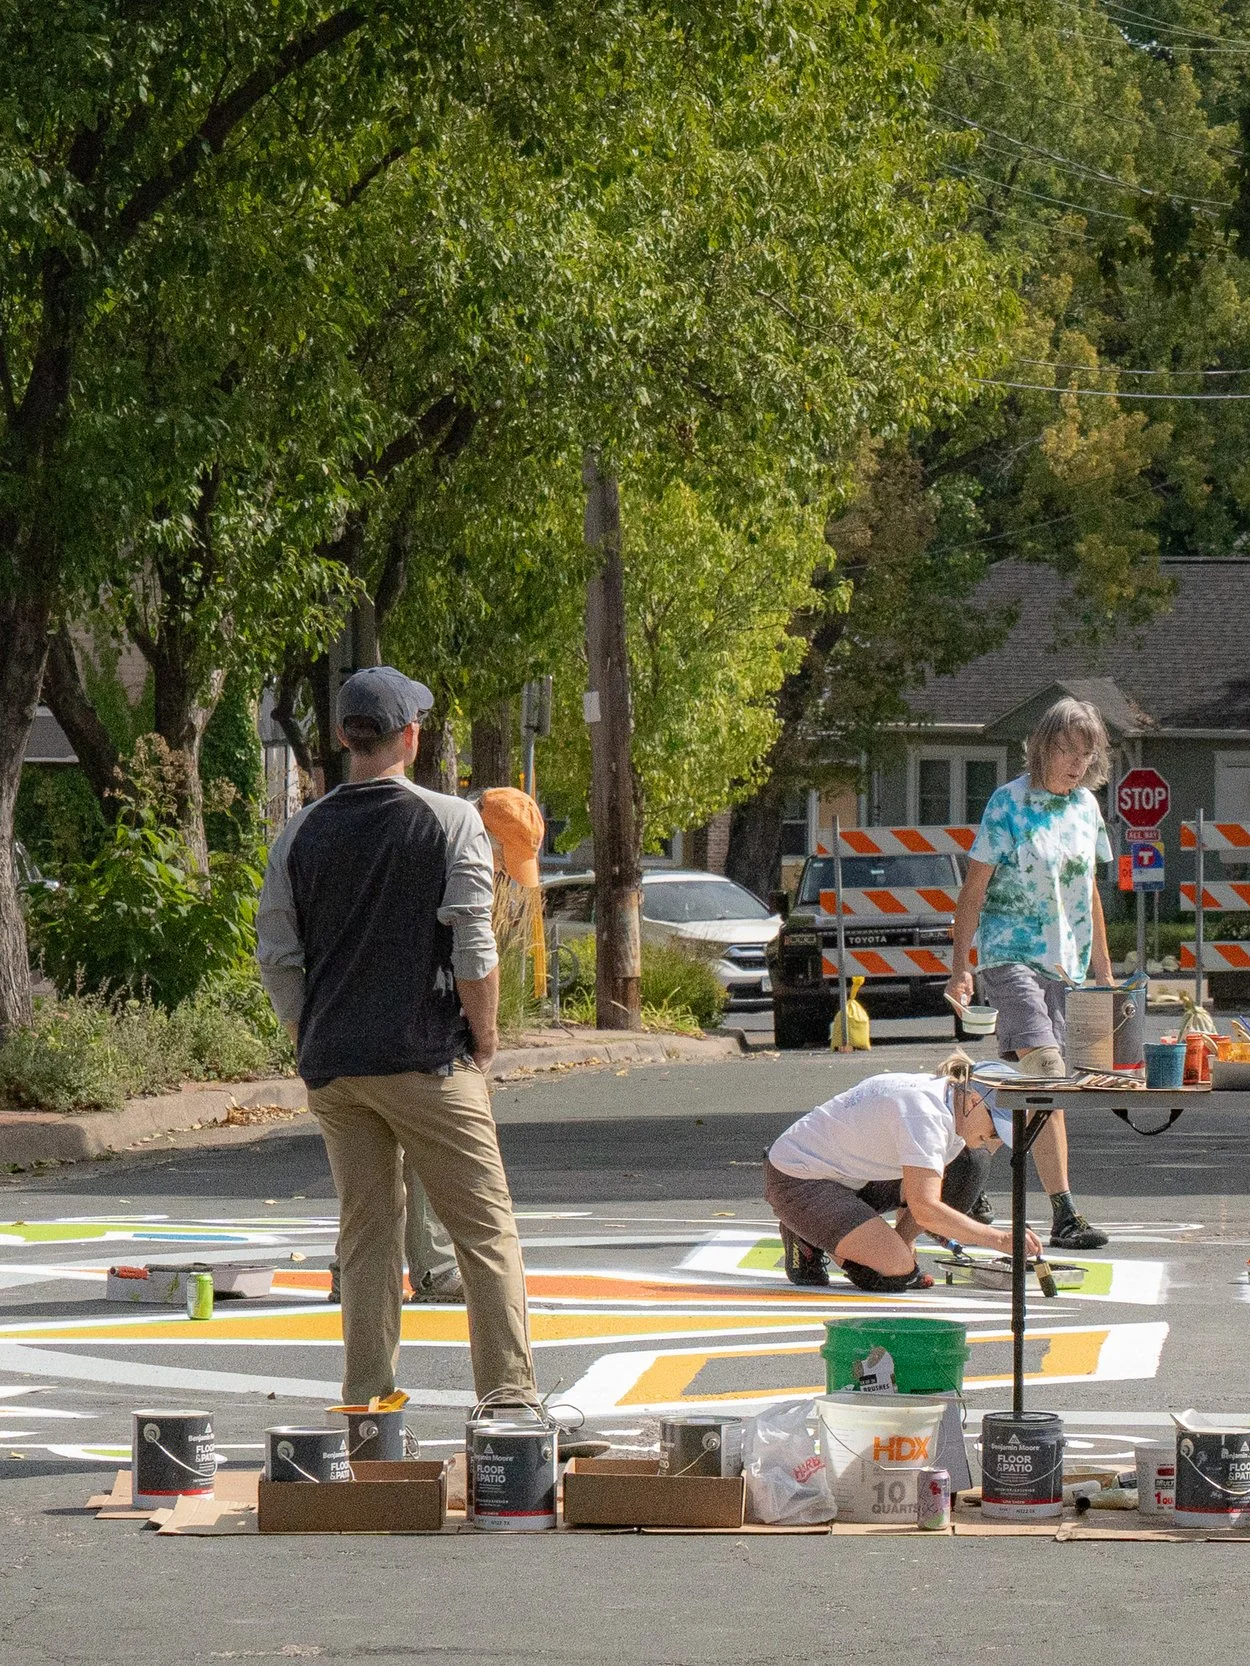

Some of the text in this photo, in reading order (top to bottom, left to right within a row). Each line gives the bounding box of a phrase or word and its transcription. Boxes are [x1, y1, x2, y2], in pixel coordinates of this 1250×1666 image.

[1120, 787, 1167, 810] STOP
[849, 935, 888, 944] TOYOTA
[873, 1435, 932, 1461] HDX
[991, 1443, 1018, 1451] Benjamin
[996, 1454, 1032, 1463] FLOOR
[996, 1463, 1033, 1473] &PATIO
[872, 1481, 906, 1504] 10
